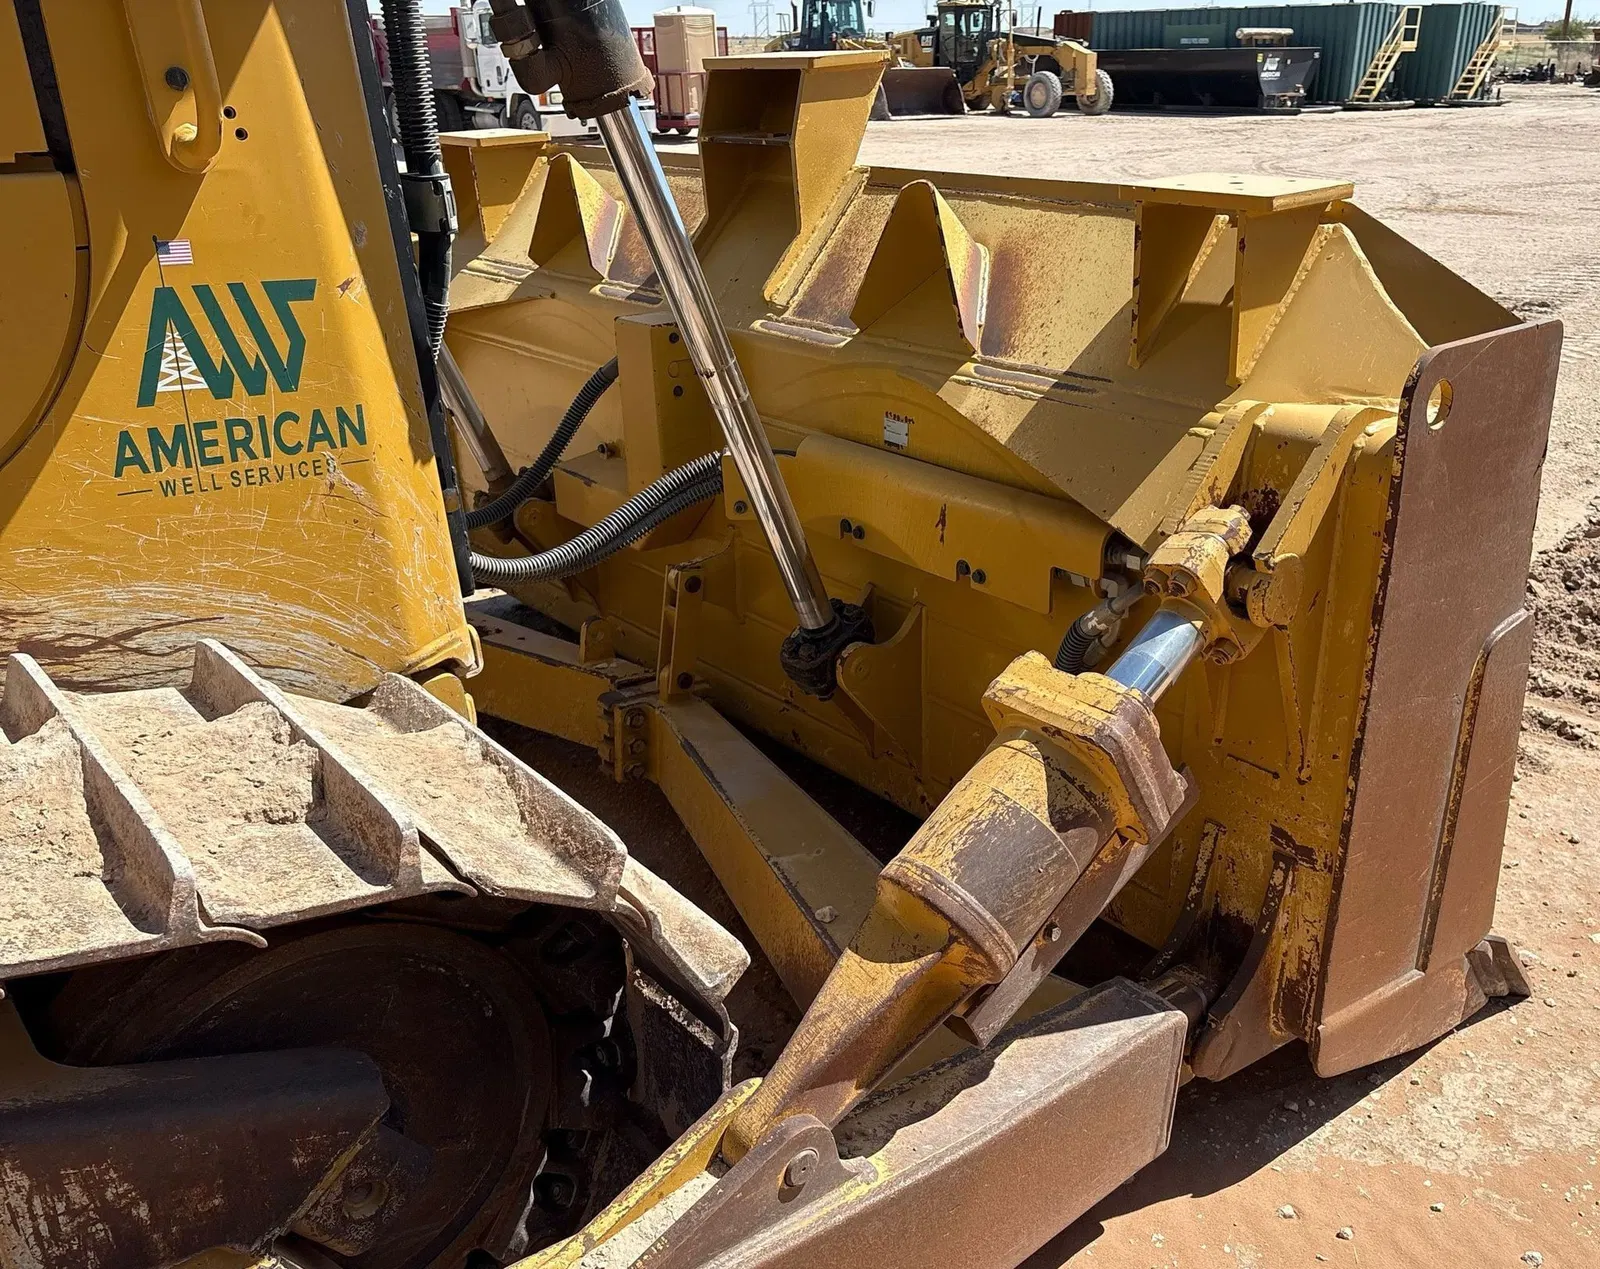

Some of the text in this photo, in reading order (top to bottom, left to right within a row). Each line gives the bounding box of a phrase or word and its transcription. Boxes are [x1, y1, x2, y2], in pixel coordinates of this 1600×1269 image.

[114, 404, 368, 478] AMERICAN
[159, 458, 337, 497] WELL SERVICES
